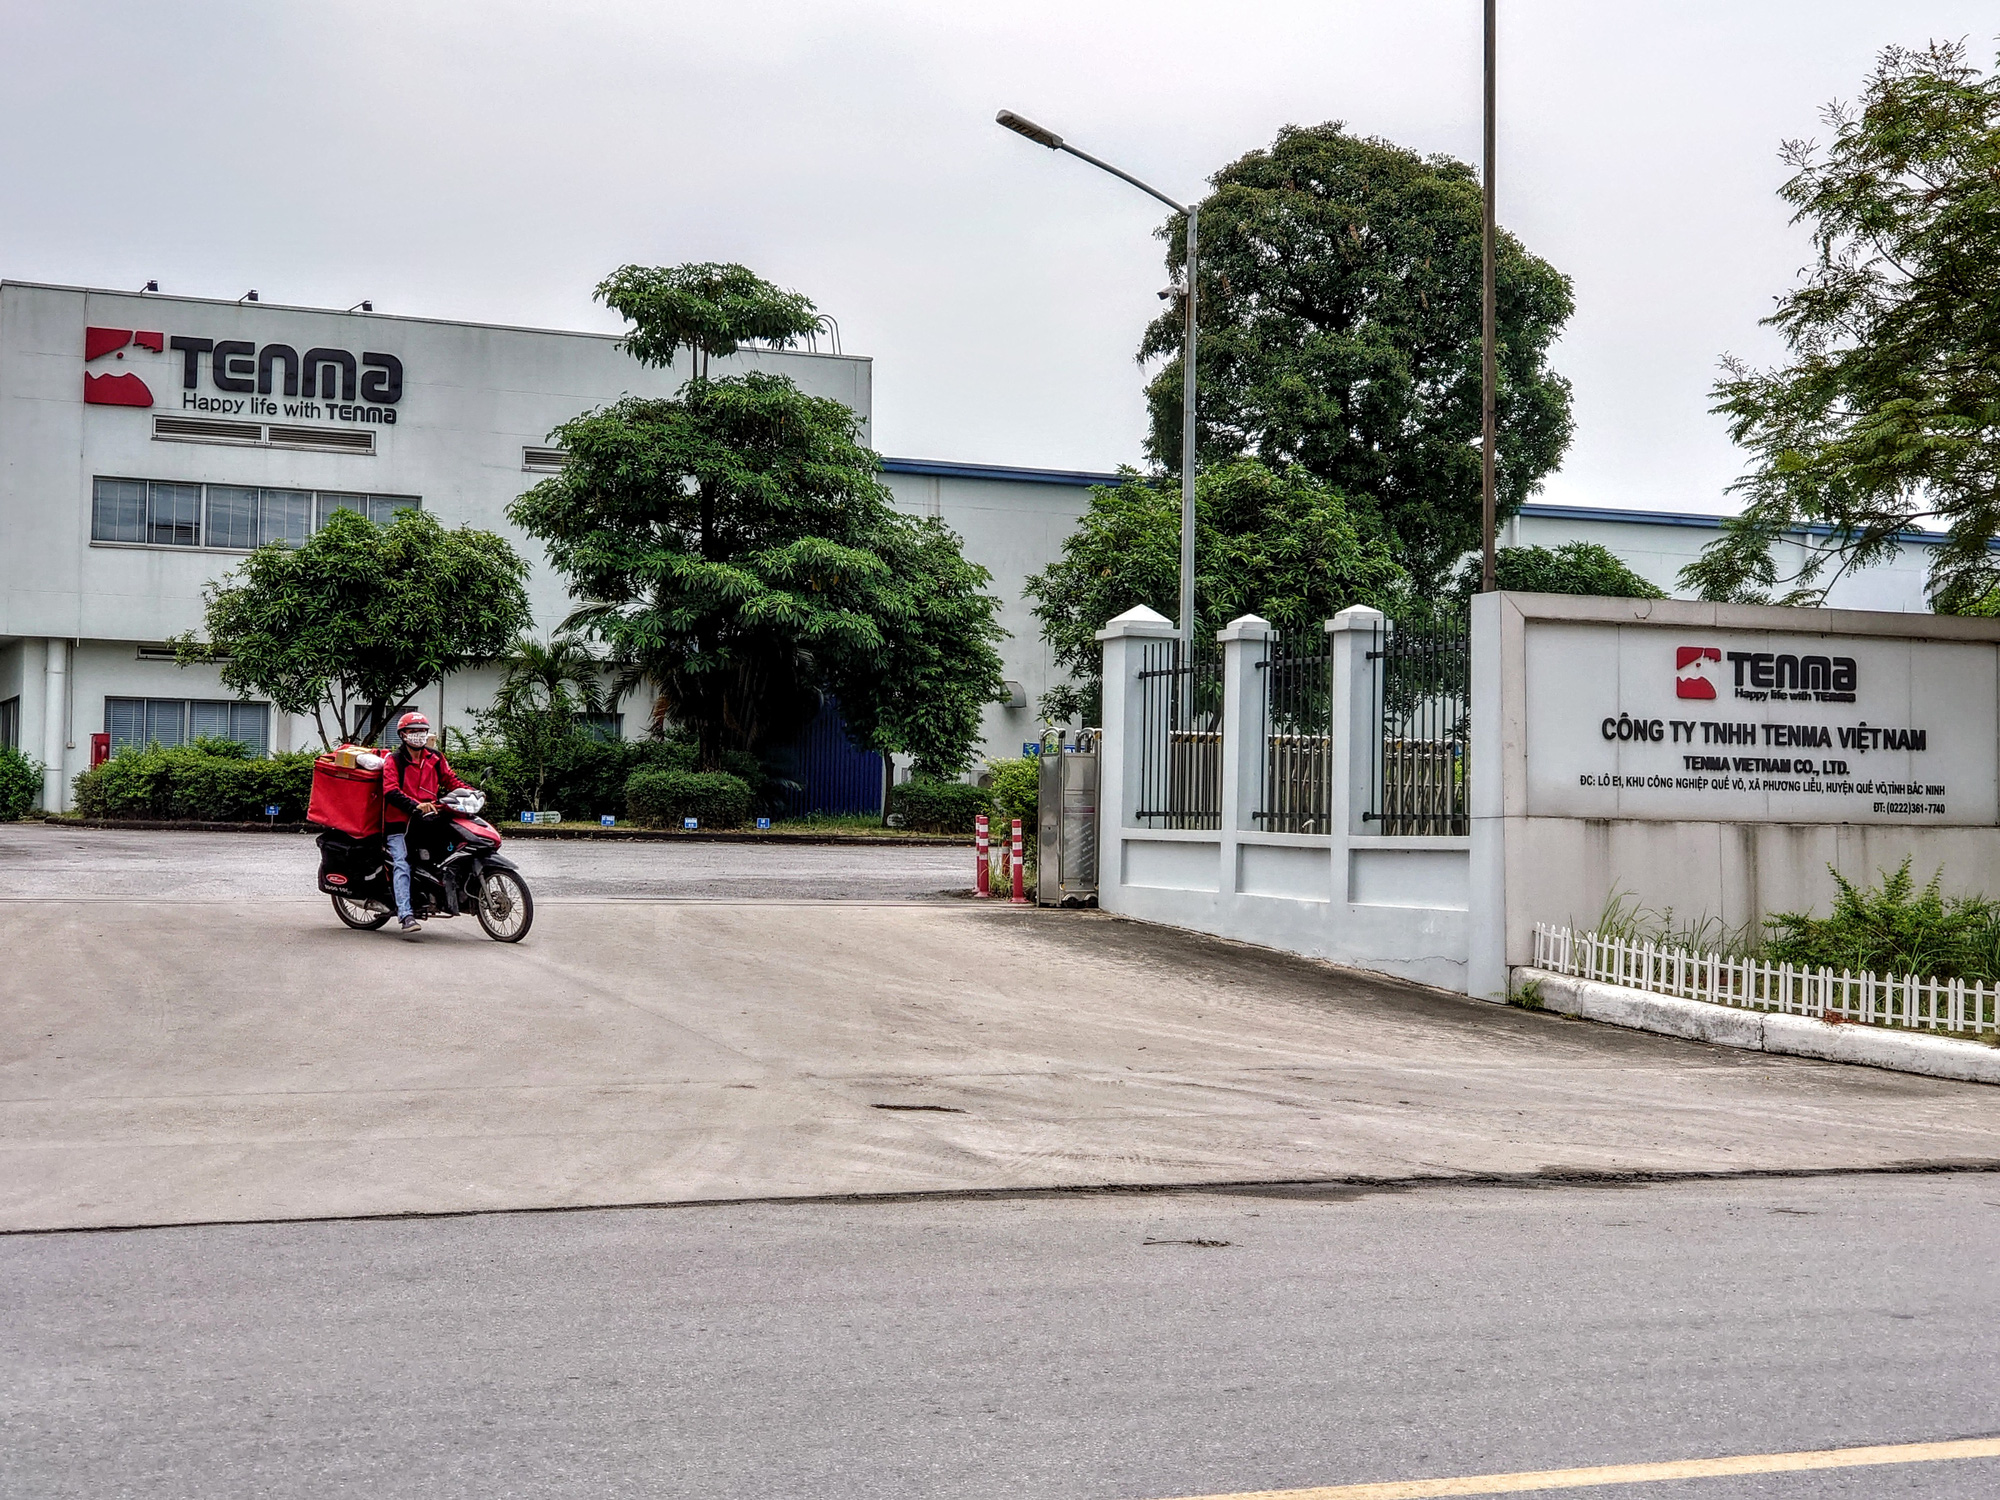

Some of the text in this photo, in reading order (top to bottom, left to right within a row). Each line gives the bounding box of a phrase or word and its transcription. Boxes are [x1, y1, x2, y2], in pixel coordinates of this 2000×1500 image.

[183, 392, 244, 414] Happy
[250, 396, 277, 415] life
[284, 401, 320, 419] with
[1735, 688, 1768, 701] Happy
[1770, 690, 1788, 700] life
[1602, 712, 1664, 742] CÔNG
[1669, 721, 1696, 743] TY
[1700, 722, 1756, 745] TNHH
[1761, 724, 1832, 748] TENMA
[1683, 756, 1850, 776] TENMA VIETNAM CO., LTD.
[1598, 773, 1610, 786] LÔ
[1626, 776, 1645, 788] KHU
[1647, 773, 1673, 789] CÔNG
[1675, 776, 1709, 791] NGHIỆP
[1826, 780, 1854, 795] HUYỆN
[1926, 785, 1946, 796] NINH
